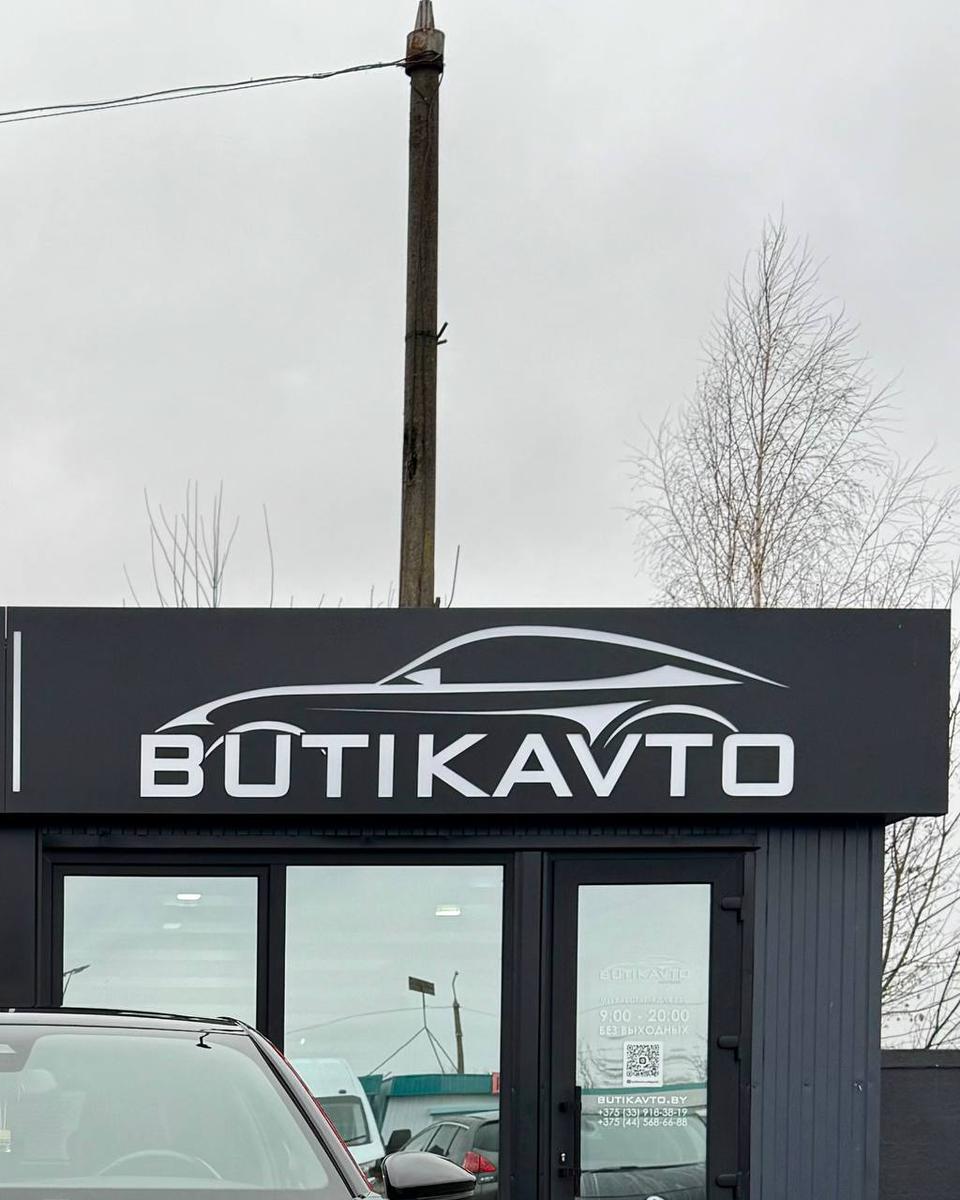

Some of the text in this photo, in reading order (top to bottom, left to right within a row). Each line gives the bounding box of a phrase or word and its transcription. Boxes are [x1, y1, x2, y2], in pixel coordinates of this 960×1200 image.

[141, 731, 795, 798] BUTIKAVTO
[599, 967, 689, 980] BUTIKAVTO
[600, 1009, 631, 1022] 9:00
[648, 1009, 689, 1022] 20:00
[599, 1026, 688, 1036] БЕЗ ВЫХОДНЫХ
[597, 1096, 688, 1104] BUTIKAVTO.BY
[598, 1107, 688, 1118] +375 (33) 918-38-19
[598, 1117, 688, 1128] +375 (44) 568-66-88
